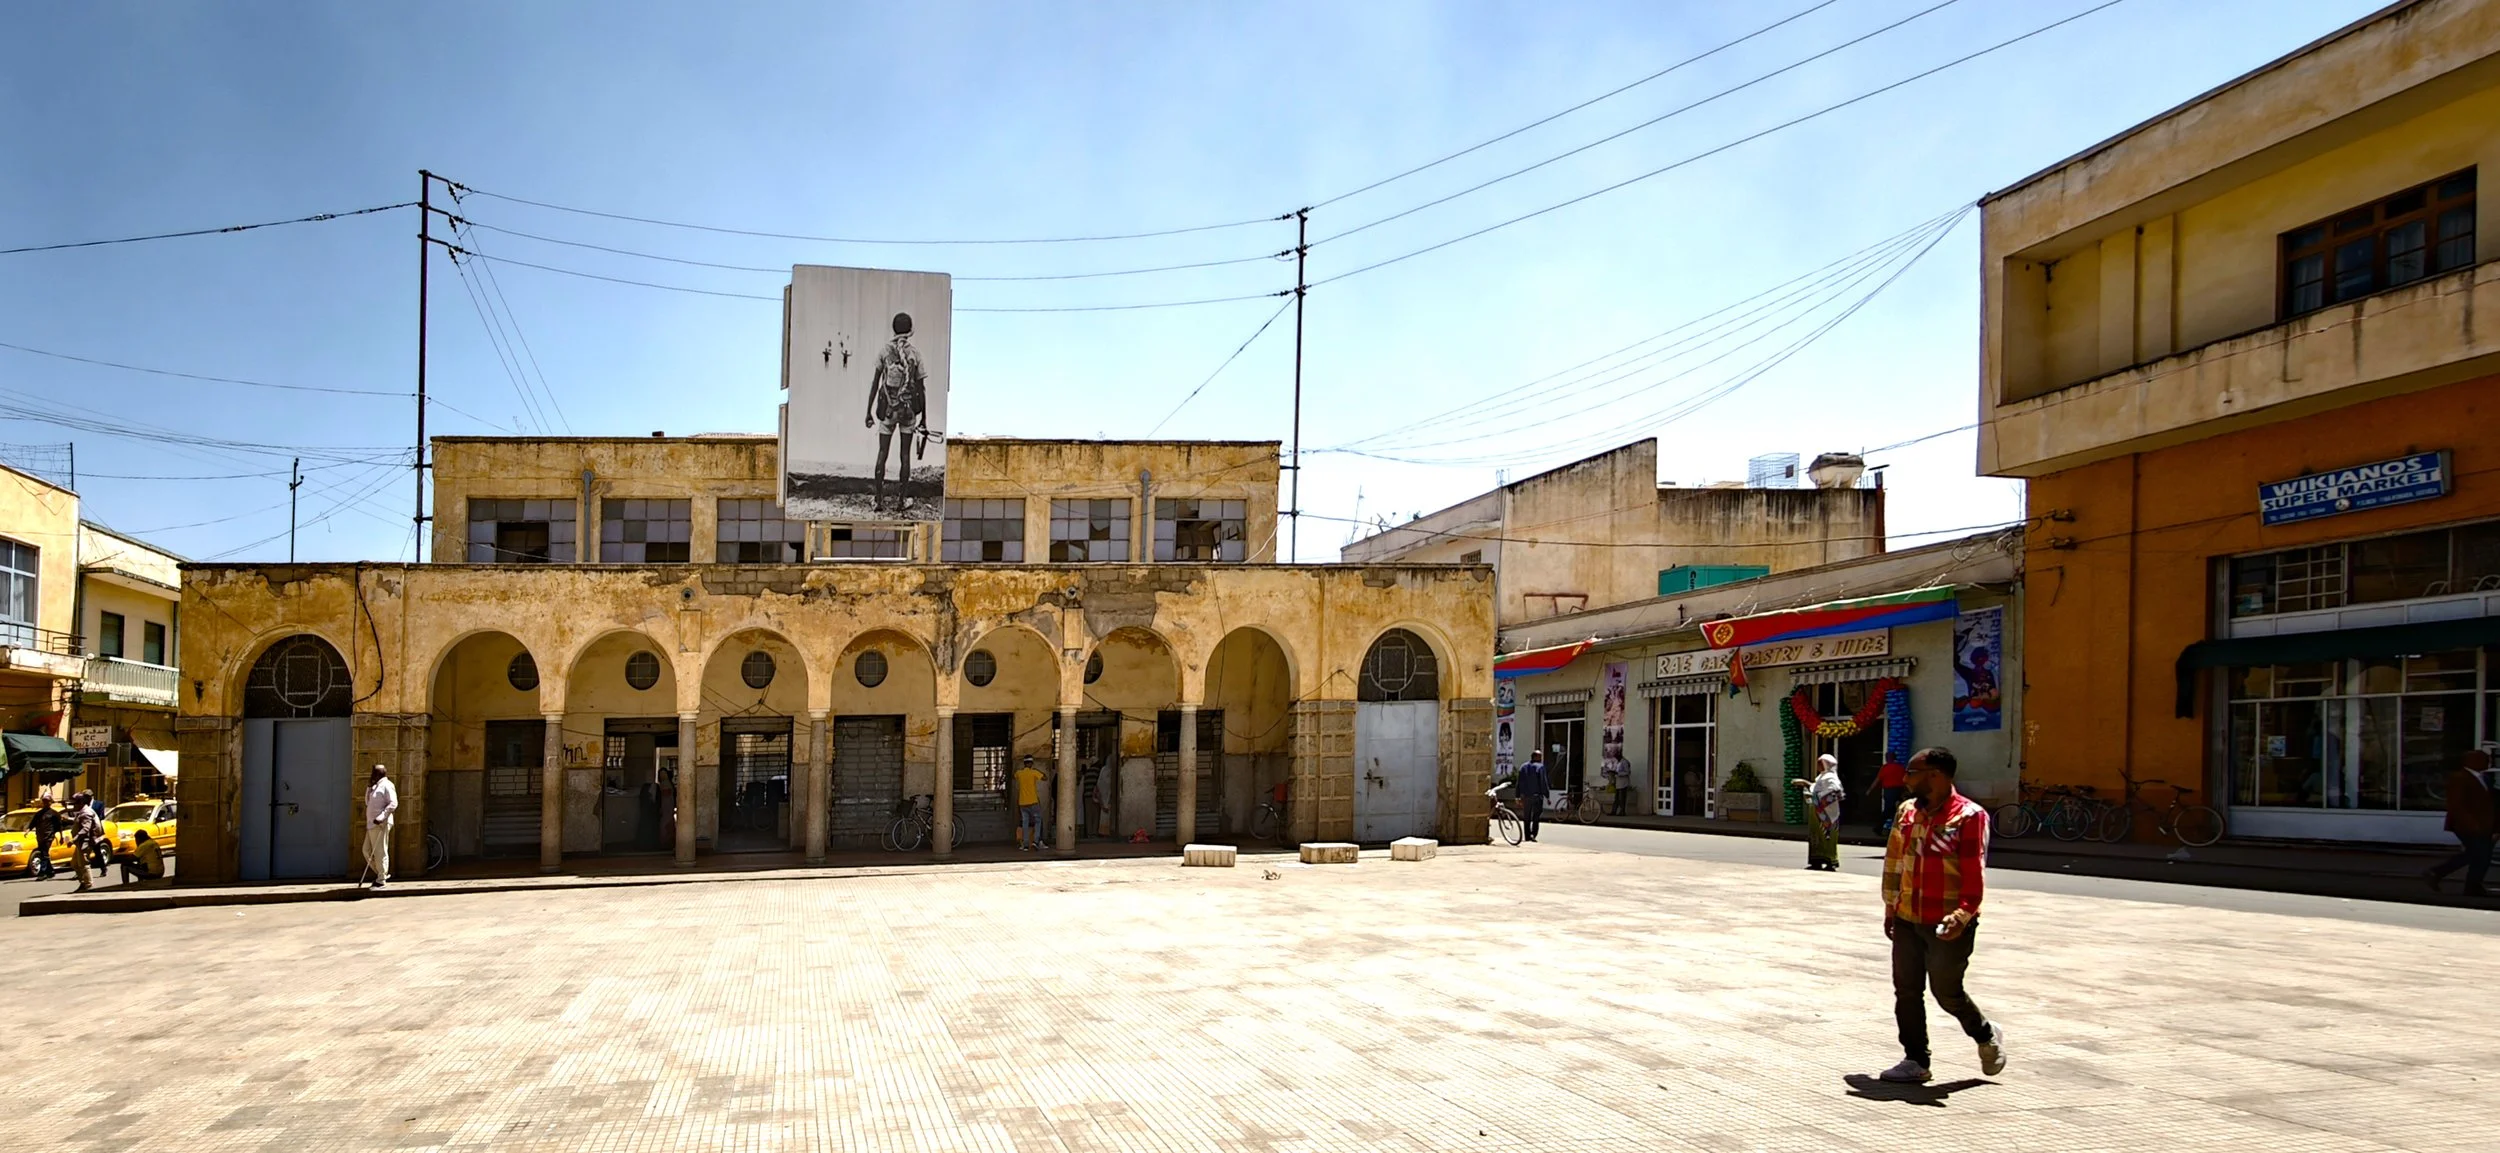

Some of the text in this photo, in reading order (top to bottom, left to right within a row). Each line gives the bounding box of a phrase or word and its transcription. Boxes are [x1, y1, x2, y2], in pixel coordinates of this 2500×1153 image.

[2263, 489, 2329, 510] SUPER
[2337, 470, 2436, 497] MARKET
[2272, 457, 2423, 497] WIKIANOS
[1658, 636, 1886, 676] RAE CAF PASTRY & JUICE
